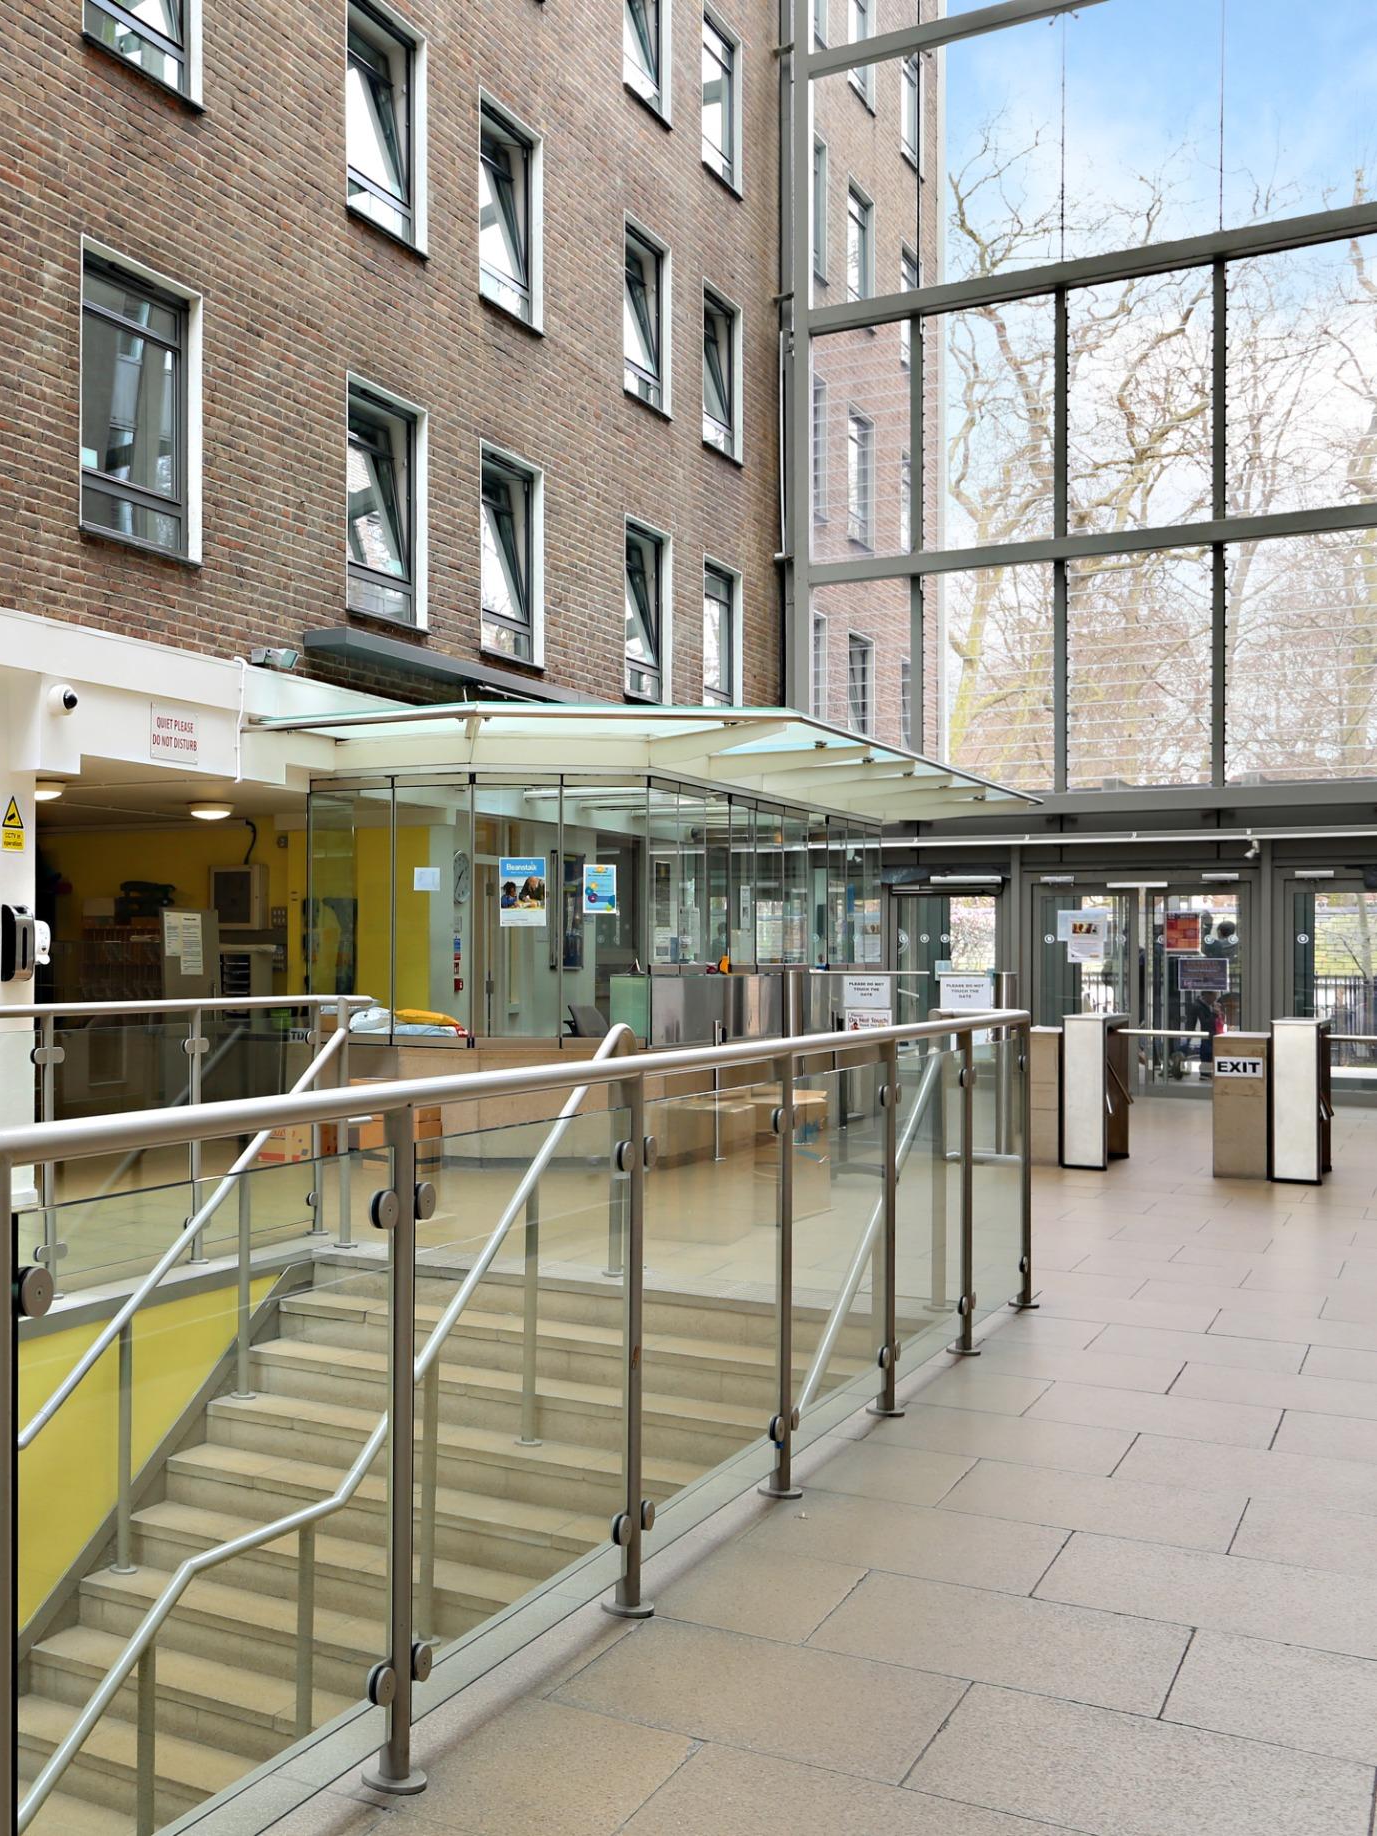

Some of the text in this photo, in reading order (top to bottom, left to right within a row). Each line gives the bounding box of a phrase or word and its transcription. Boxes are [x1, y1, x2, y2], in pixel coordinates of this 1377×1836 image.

[156, 716, 194, 734] QUIET PLEASE
[153, 733, 198, 751] DO NOT DISTURB
[1217, 1061, 1261, 1073] EXIT
